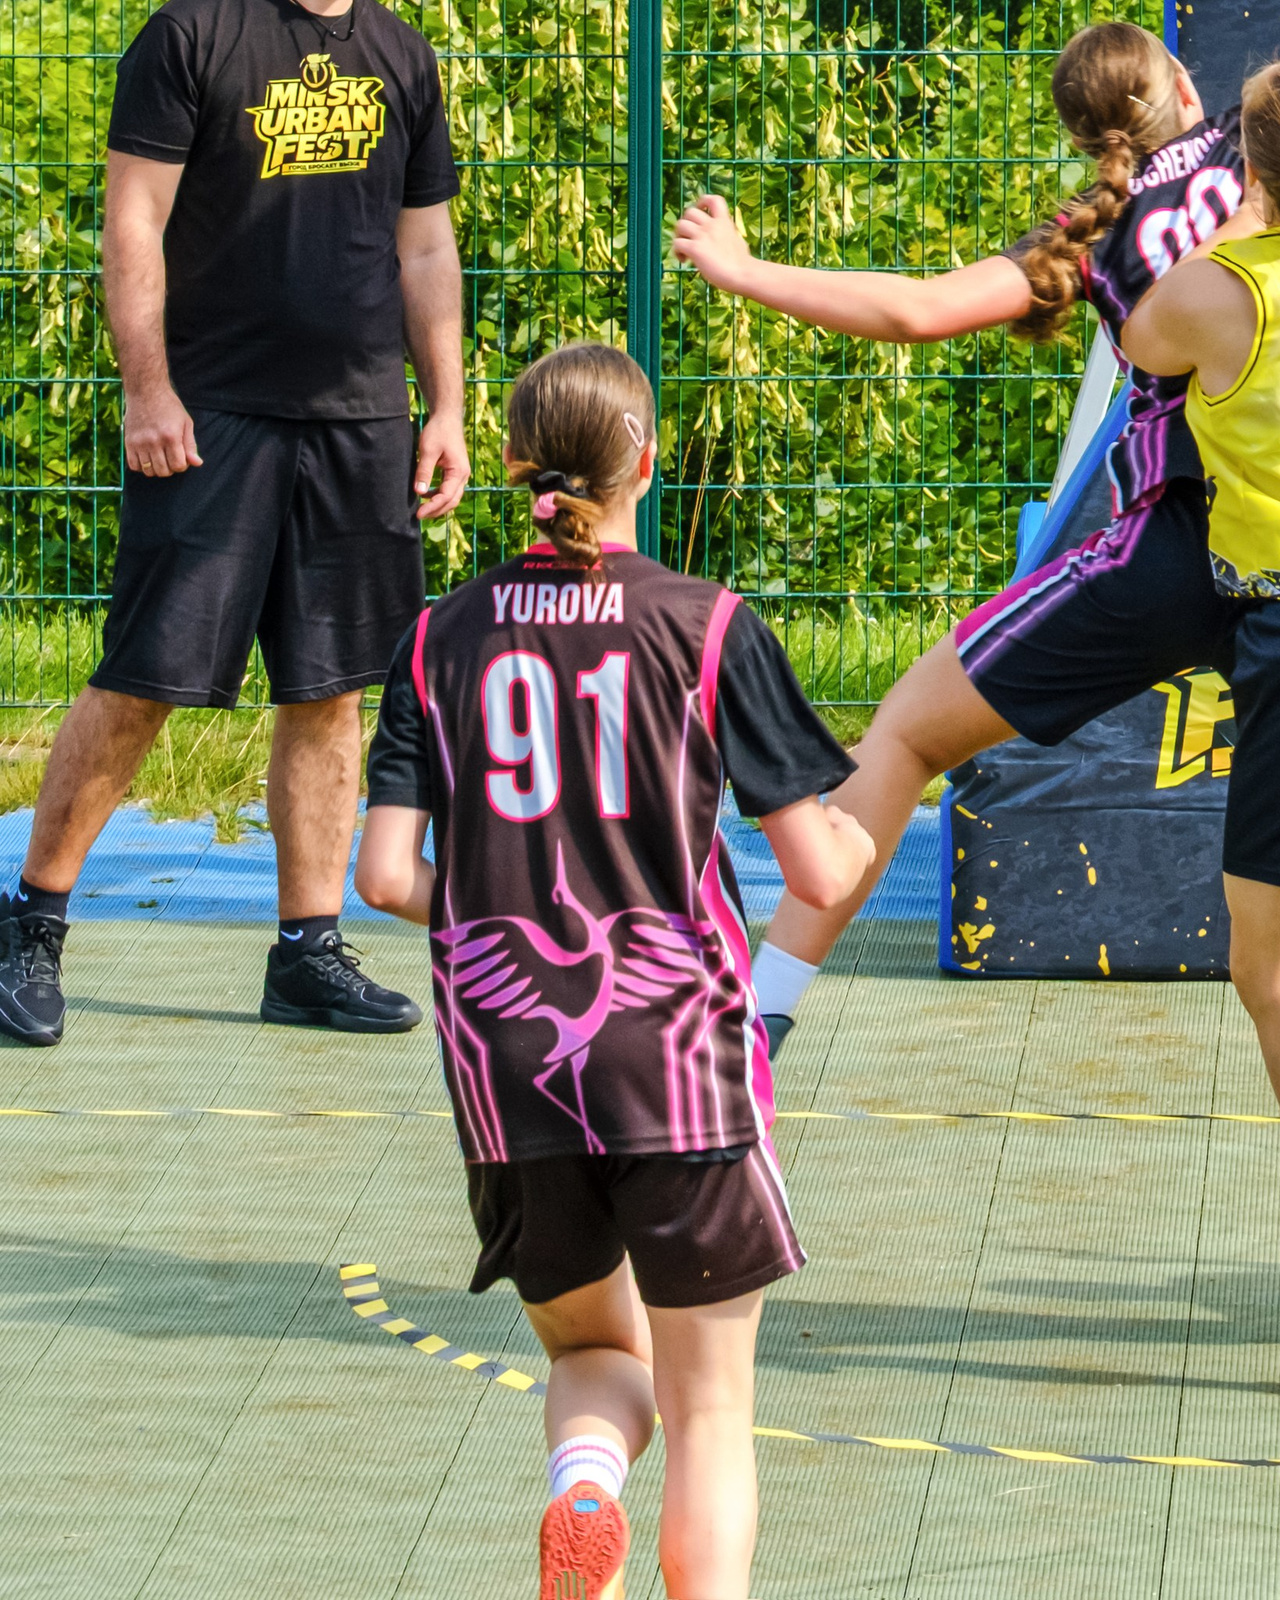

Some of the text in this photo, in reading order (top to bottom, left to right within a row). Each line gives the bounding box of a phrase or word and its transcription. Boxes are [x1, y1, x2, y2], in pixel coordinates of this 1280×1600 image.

[268, 80, 374, 109] MINSK
[259, 105, 378, 136] URBAN
[270, 131, 369, 170] FEST
[492, 583, 624, 625] YUROVA
[481, 649, 631, 823] 91
